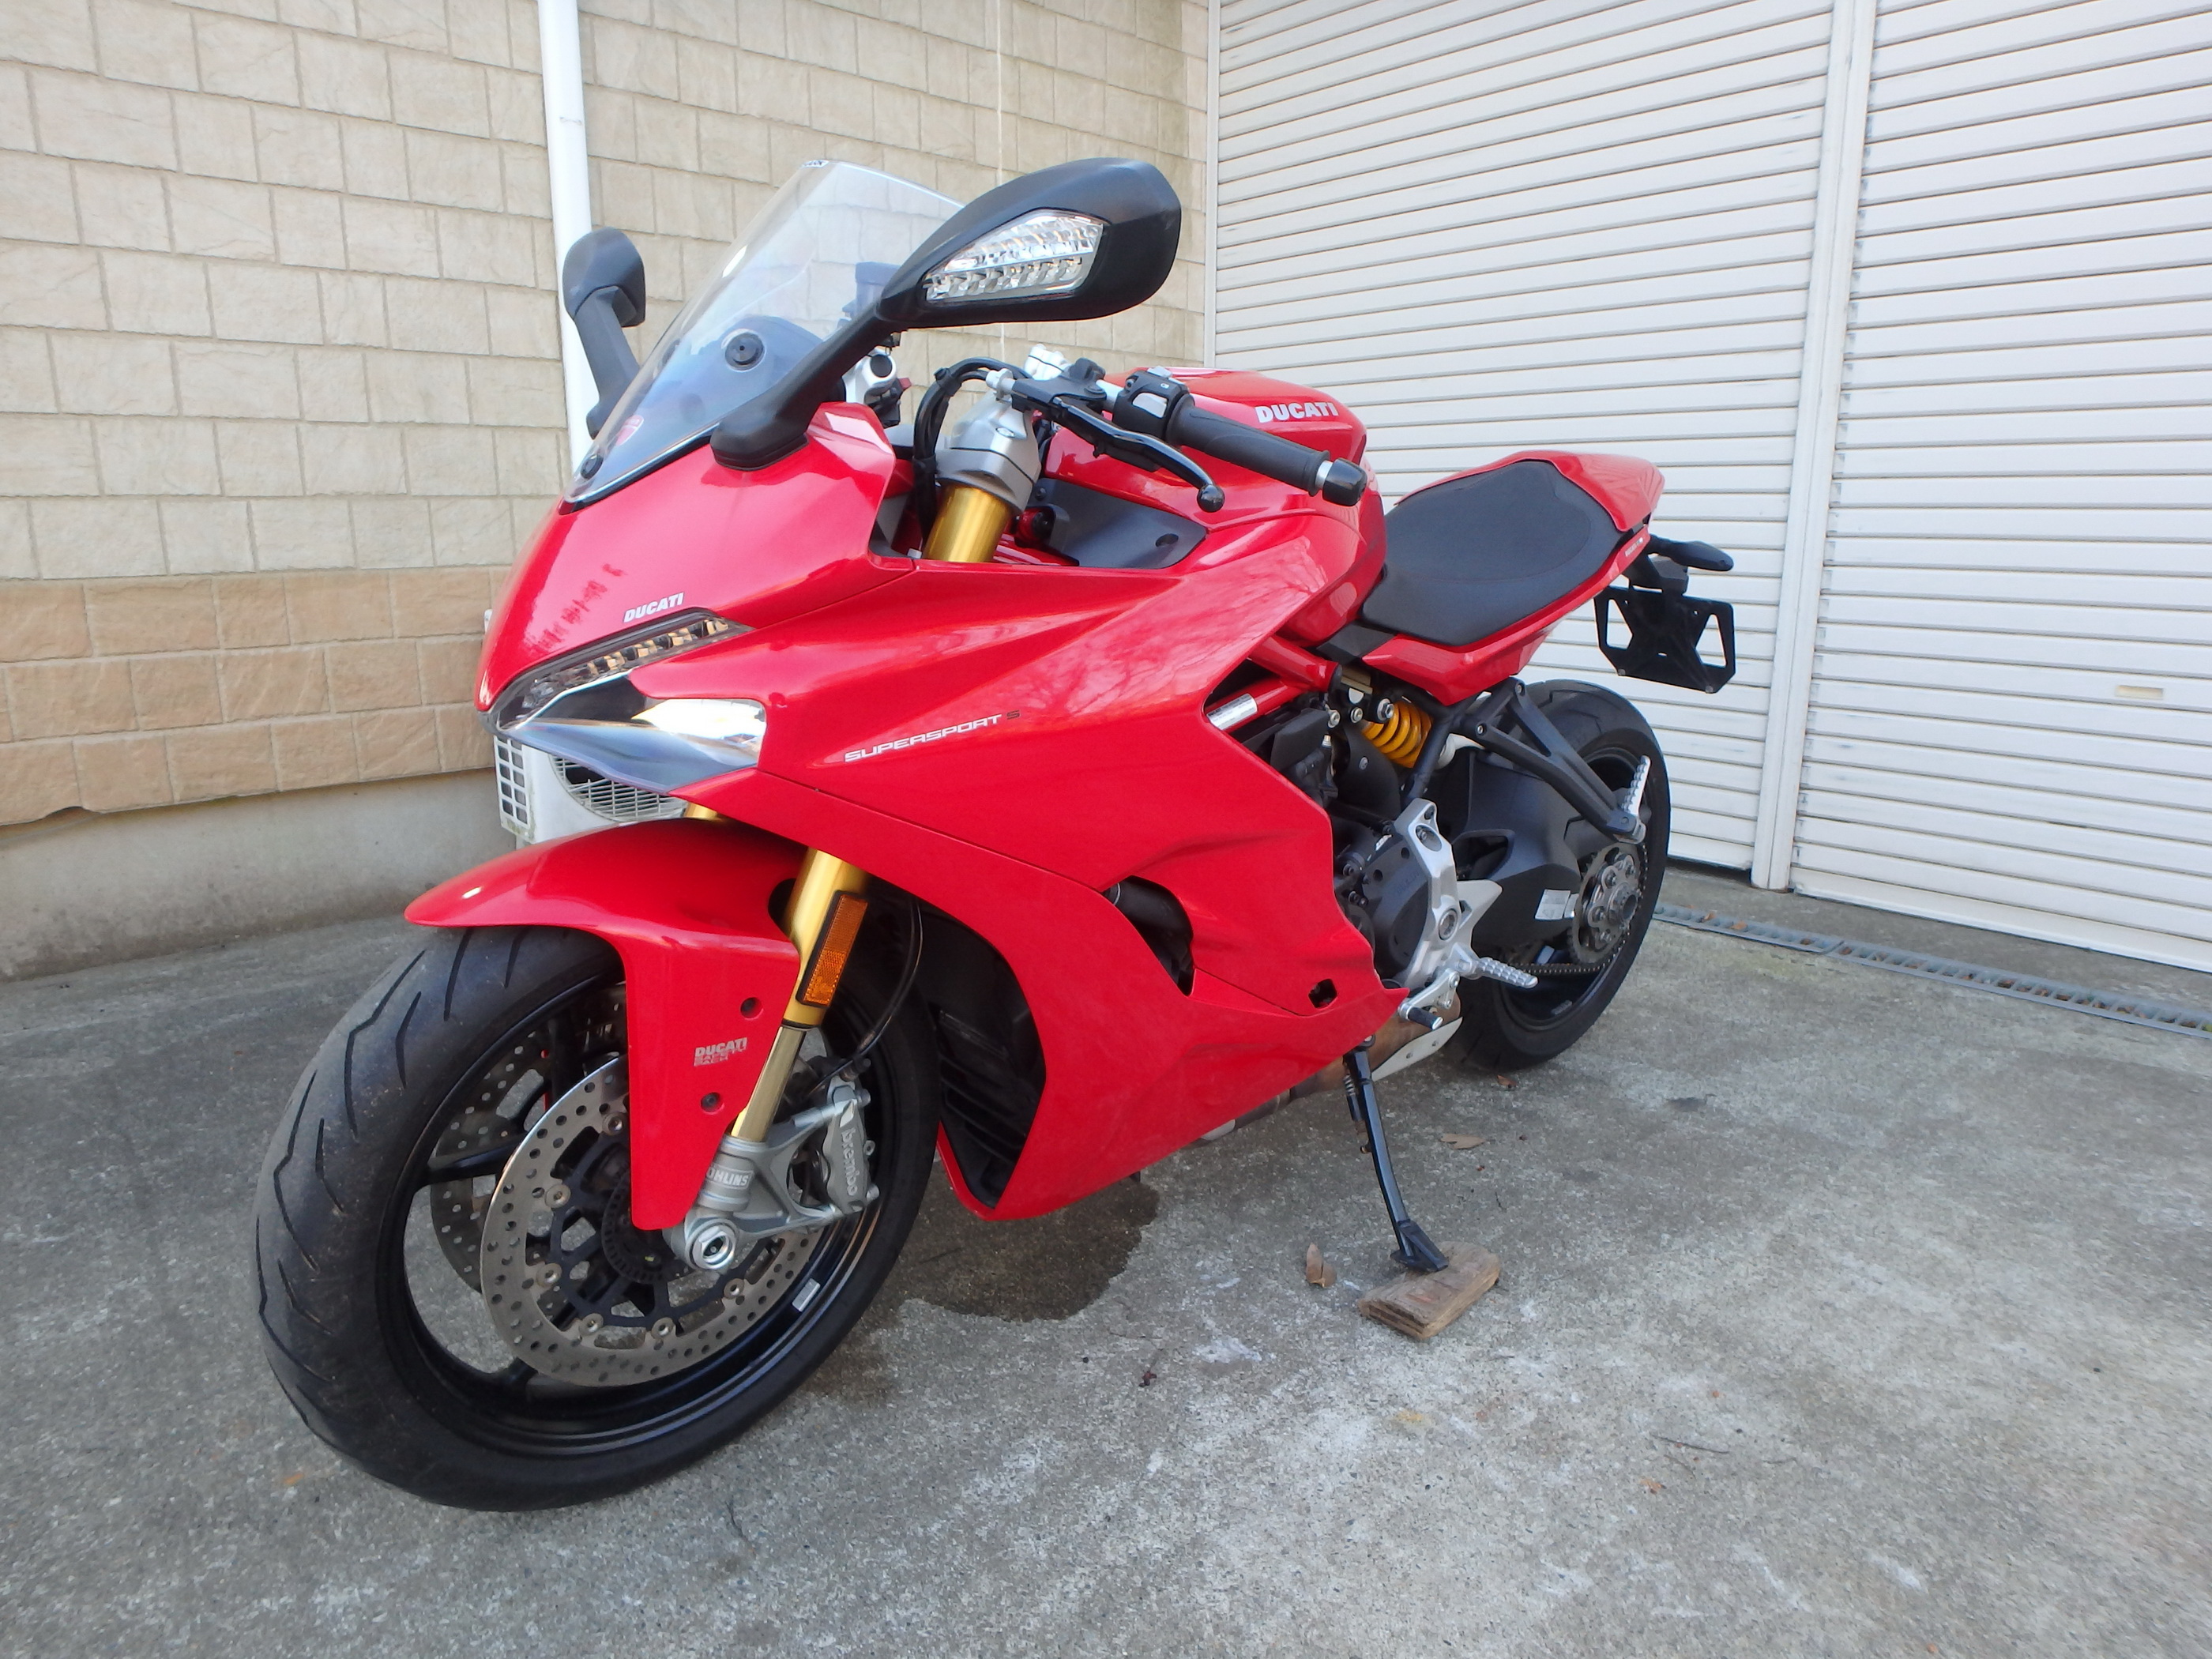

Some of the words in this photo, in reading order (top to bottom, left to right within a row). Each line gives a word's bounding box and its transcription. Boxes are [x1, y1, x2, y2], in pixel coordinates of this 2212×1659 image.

[1255, 401, 1339, 423] DUCATI
[623, 592, 684, 623] DUCATI
[845, 713, 1003, 762] SUPERSPORT
[1006, 709, 1021, 720] S
[694, 1036, 747, 1057] DUCATI
[841, 1127, 860, 1196] brembo
